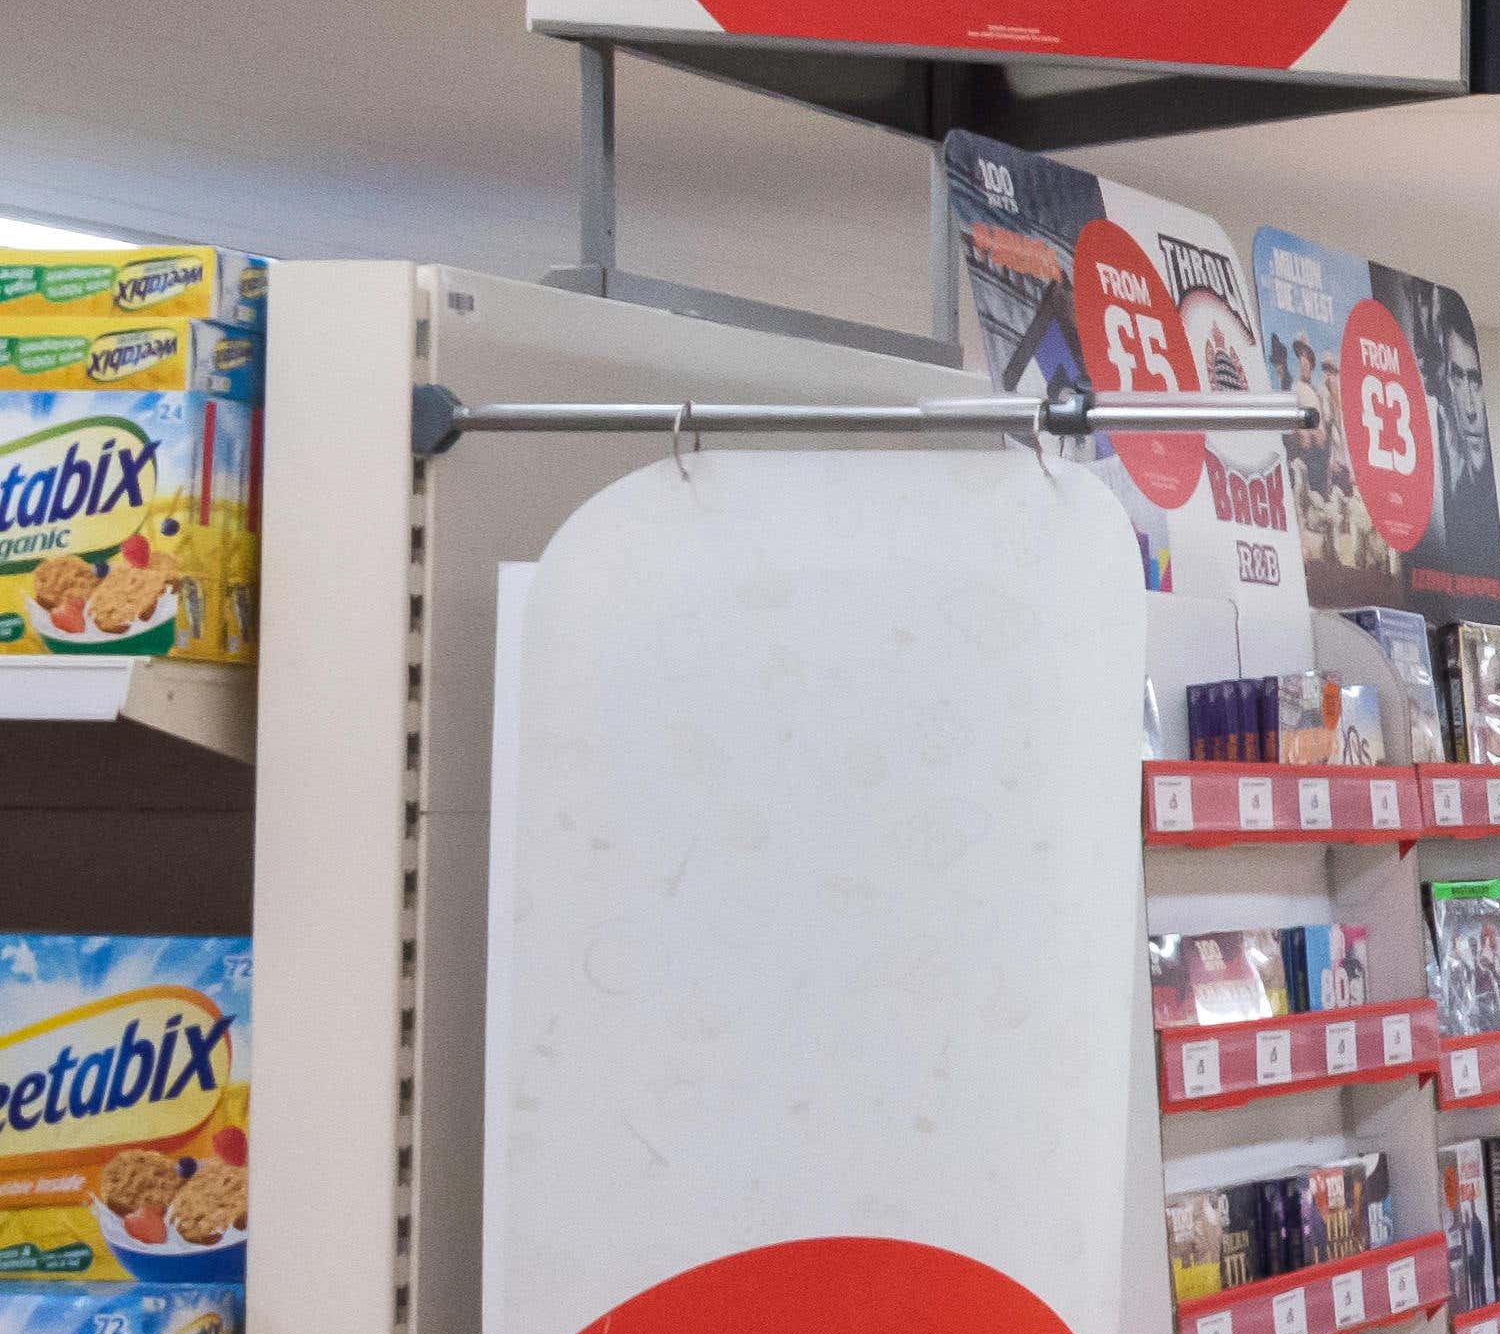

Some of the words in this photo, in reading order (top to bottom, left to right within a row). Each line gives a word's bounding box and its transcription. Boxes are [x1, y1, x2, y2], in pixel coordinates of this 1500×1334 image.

[113, 264, 204, 308] Weetabix
[1096, 261, 1150, 307] FROM
[86, 337, 179, 381] Weetabix
[1102, 303, 1178, 394] £5
[1359, 337, 1400, 374] FROM
[1360, 374, 1417, 477] £3
[1204, 450, 1288, 533] BACK
